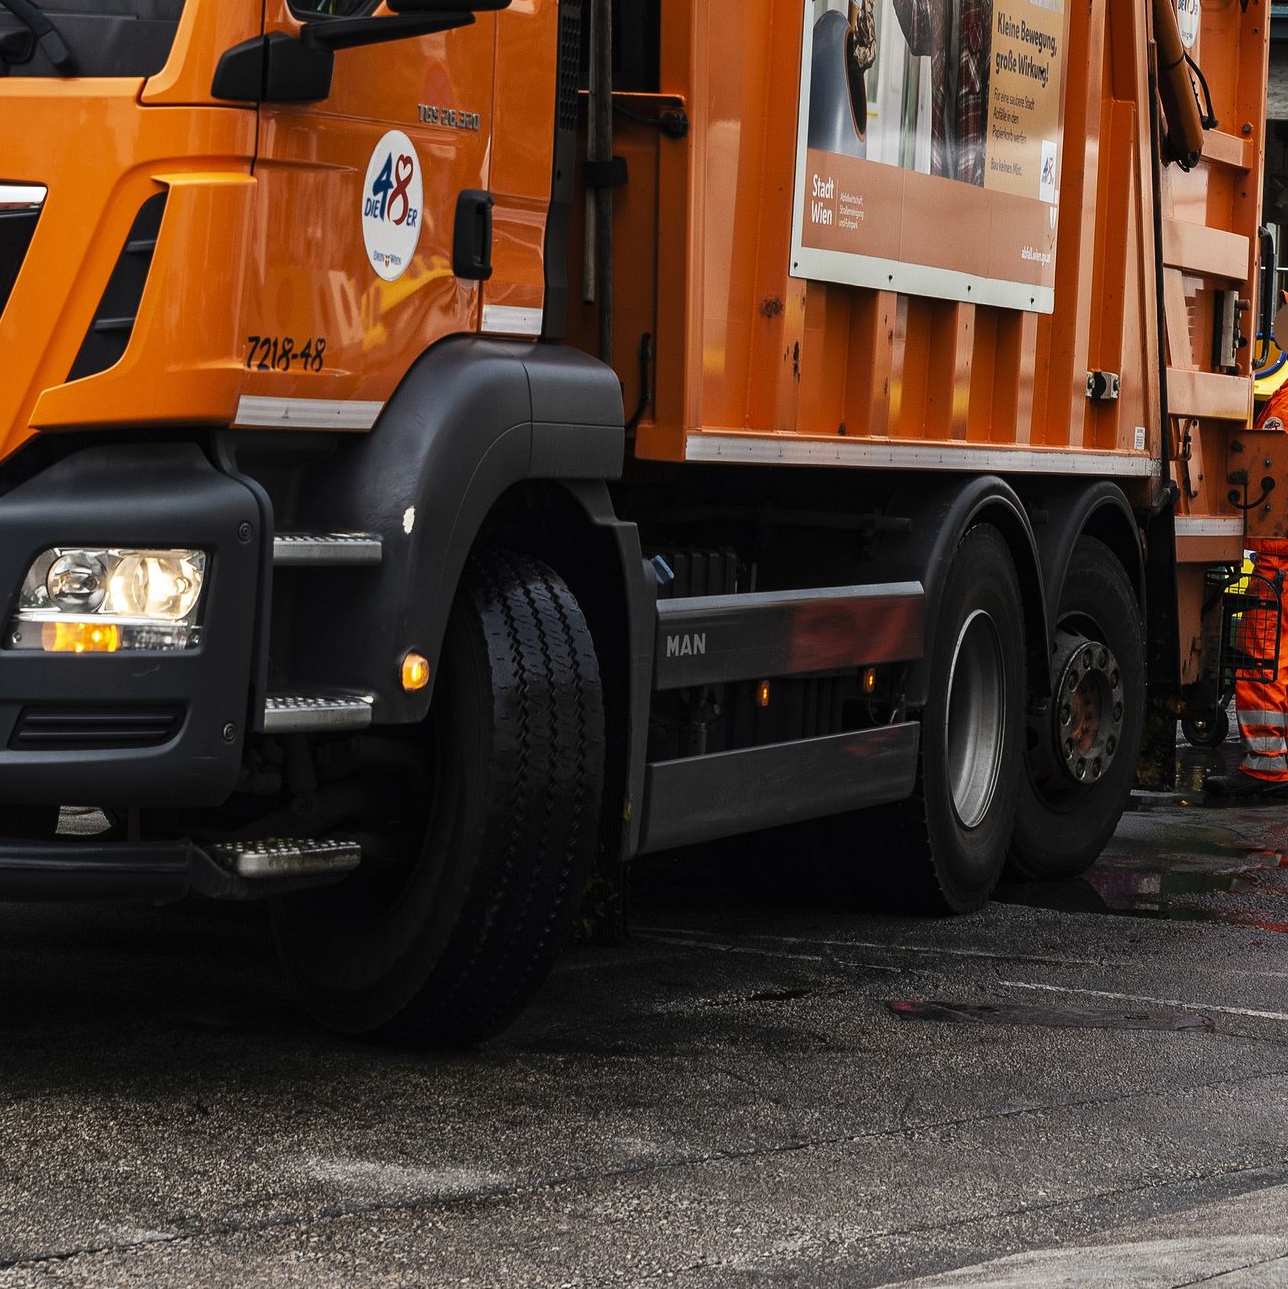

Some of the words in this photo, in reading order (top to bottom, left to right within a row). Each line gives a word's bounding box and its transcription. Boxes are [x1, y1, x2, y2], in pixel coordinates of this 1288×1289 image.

[998, 11, 1020, 40] Kleine
[1021, 20, 1058, 58] Bewegung,
[995, 49, 1017, 75] große
[1018, 53, 1050, 89] Wirkung!
[812, 174, 834, 199] Stadt
[811, 200, 833, 226] Wien
[246, 336, 326, 372] 7218-48
[666, 632, 706, 658] MAN
